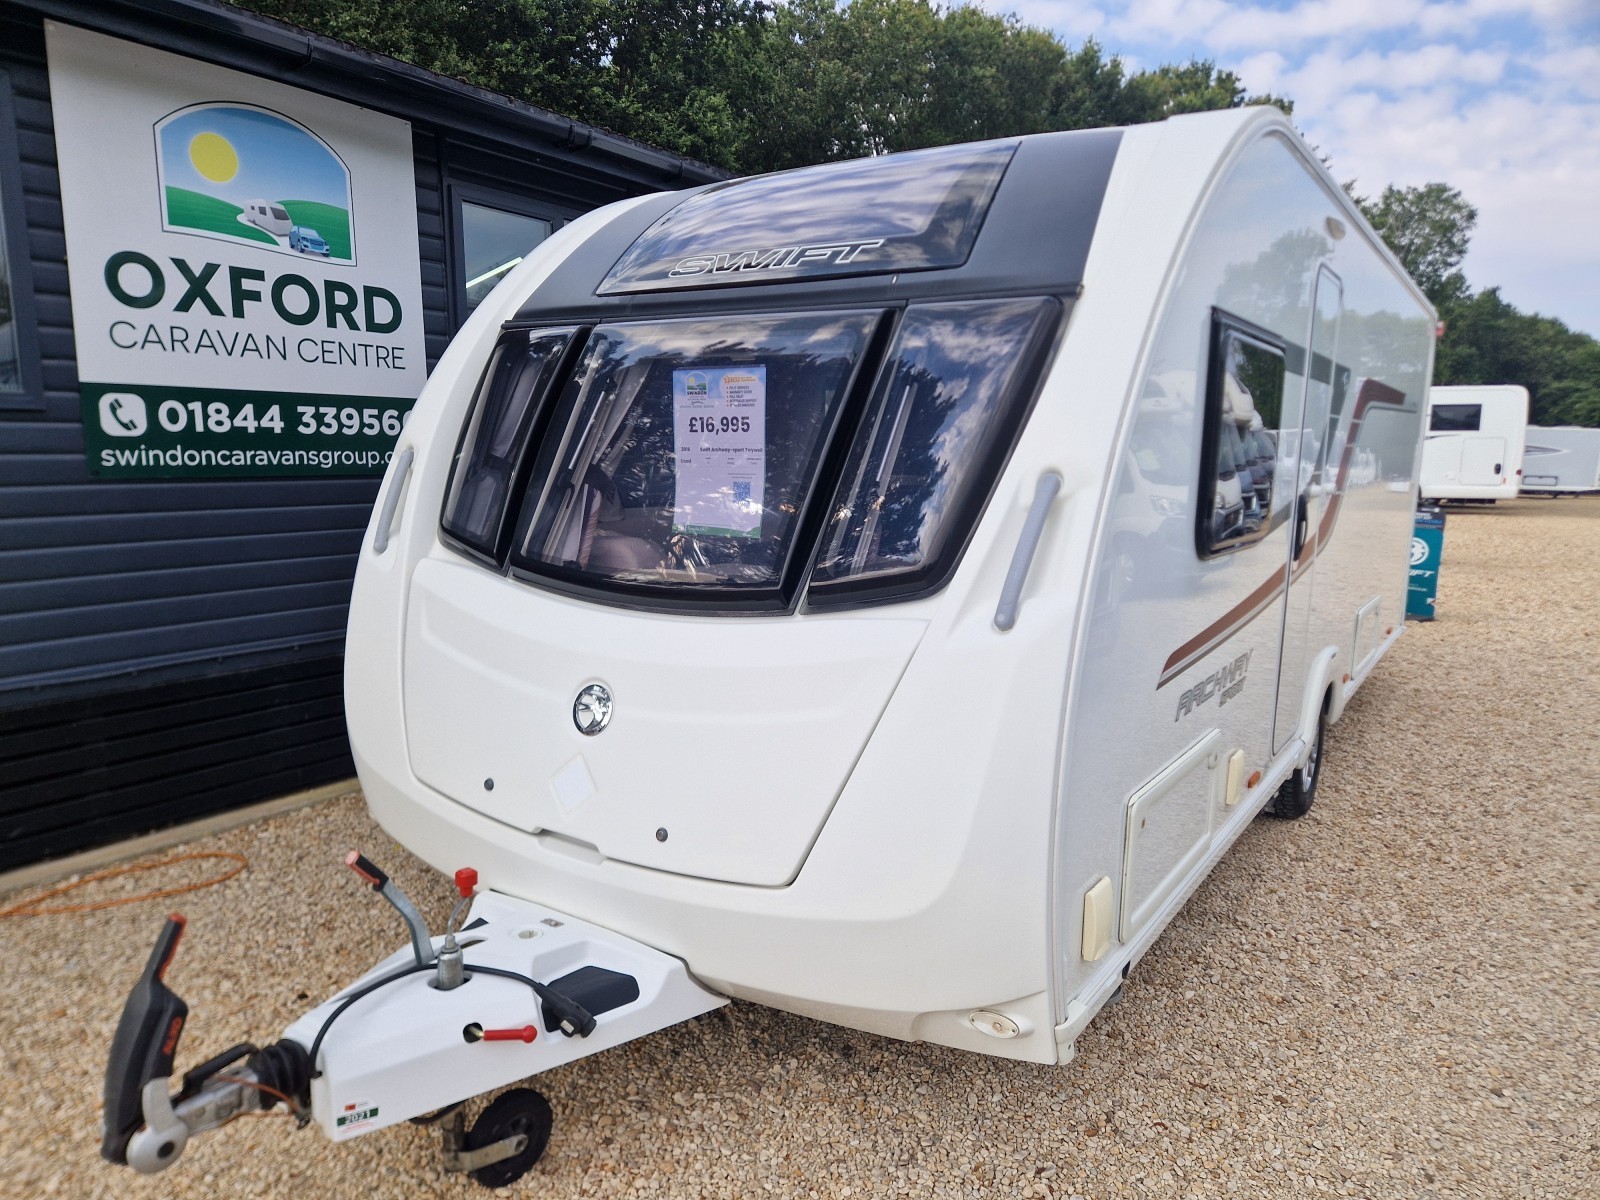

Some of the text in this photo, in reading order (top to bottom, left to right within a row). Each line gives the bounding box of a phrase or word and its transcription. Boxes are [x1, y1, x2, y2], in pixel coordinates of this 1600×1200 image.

[668, 239, 885, 278] SWIFT
[104, 250, 403, 334] OXFORD
[109, 320, 406, 370] CARAVAN CENTRE
[158, 399, 284, 434] 01844
[688, 416, 750, 435] £16,995
[1175, 648, 1254, 723] ARCHWAY
[345, 1110, 369, 1124] 2021
